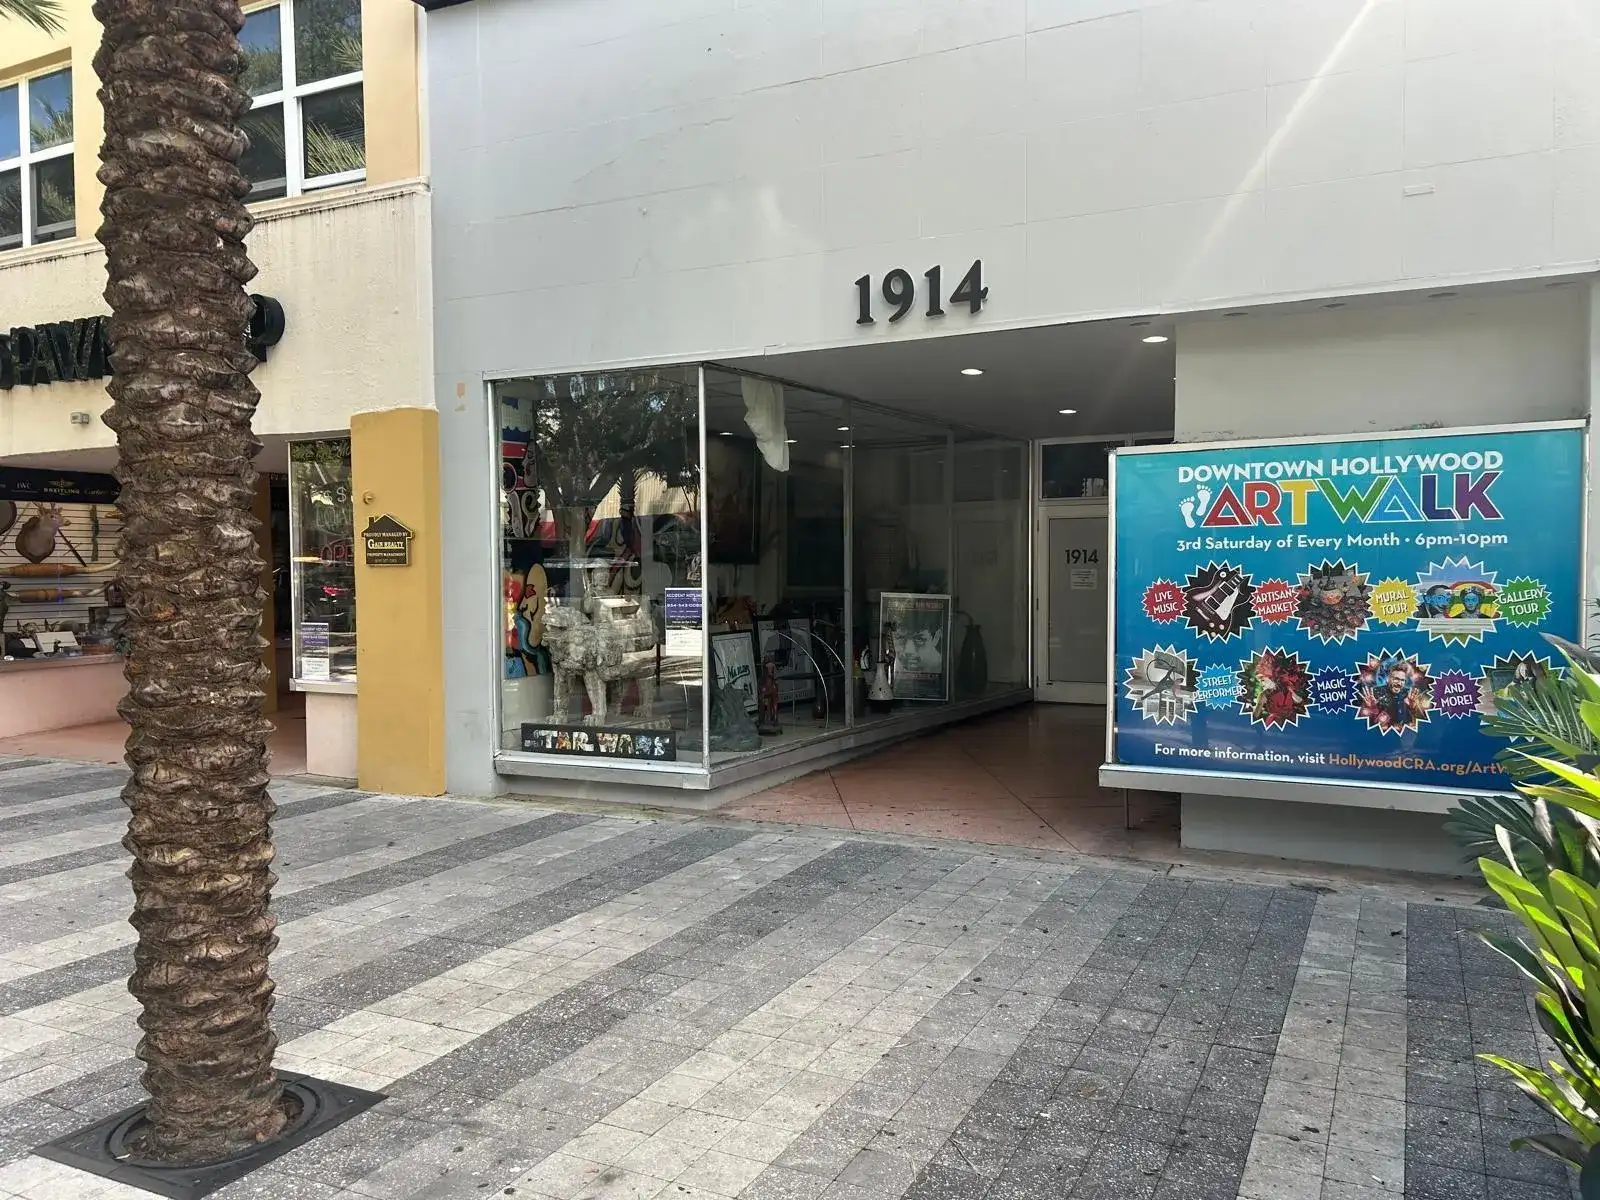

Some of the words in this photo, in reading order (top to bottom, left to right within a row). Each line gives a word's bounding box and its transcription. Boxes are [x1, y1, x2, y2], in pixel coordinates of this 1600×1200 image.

[854, 259, 989, 324] 1914
[1178, 459, 1324, 484] DOWNTOWN
[1331, 450, 1504, 476] HOLLYWOOD
[1176, 537, 1201, 551] 3rd
[1205, 536, 1272, 551] Saturday
[1276, 534, 1293, 548] of
[1297, 535, 1342, 551] Every
[1347, 532, 1400, 547] Month
[1414, 533, 1508, 549] 6pm-10pm
[1065, 549, 1099, 564] 1914
[1154, 591, 1173, 603] LIVE
[1255, 588, 1293, 604] ARTISAN
[1375, 590, 1409, 604] MURAL
[1499, 588, 1544, 604] GALLERY
[1153, 602, 1179, 614] MUSIC
[1257, 601, 1294, 615] MARKET
[1381, 602, 1408, 615] TOUR
[1509, 602, 1539, 616] TOUR
[1202, 675, 1233, 688] STREET
[1316, 678, 1347, 691] MAGIC
[1444, 682, 1465, 695] AND
[1192, 685, 1248, 701] PERFORMERS
[1319, 691, 1347, 704] SHOW
[1440, 695, 1473, 708] MORE!
[1154, 743, 1174, 755] For
[1178, 748, 1211, 758] more
[1214, 746, 1294, 764] information,
[1298, 752, 1326, 765] visit
